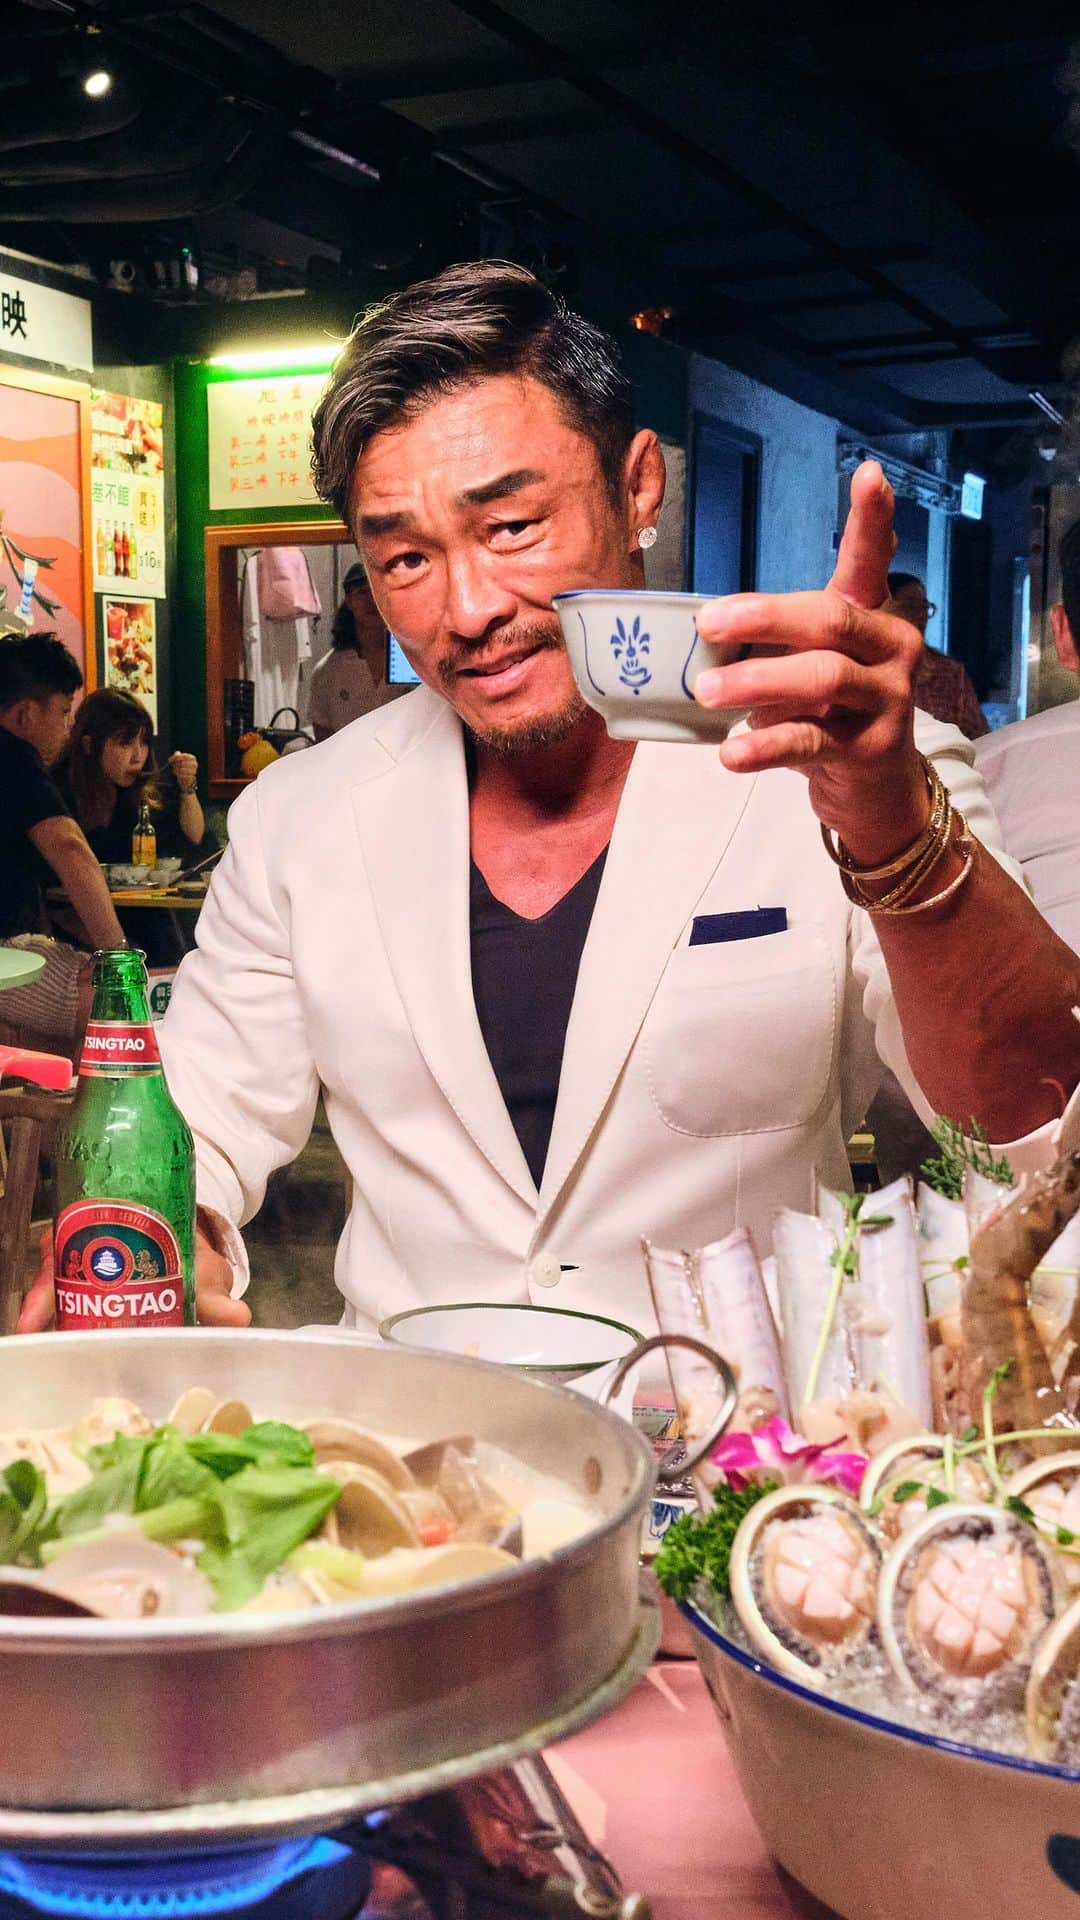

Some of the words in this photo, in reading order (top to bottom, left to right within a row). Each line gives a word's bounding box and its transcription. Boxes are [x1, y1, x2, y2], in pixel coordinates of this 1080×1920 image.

[1, 290, 27, 339] 映
[84, 1036, 145, 1051] TSINGTAO
[57, 1288, 177, 1318] TSINGTAO
